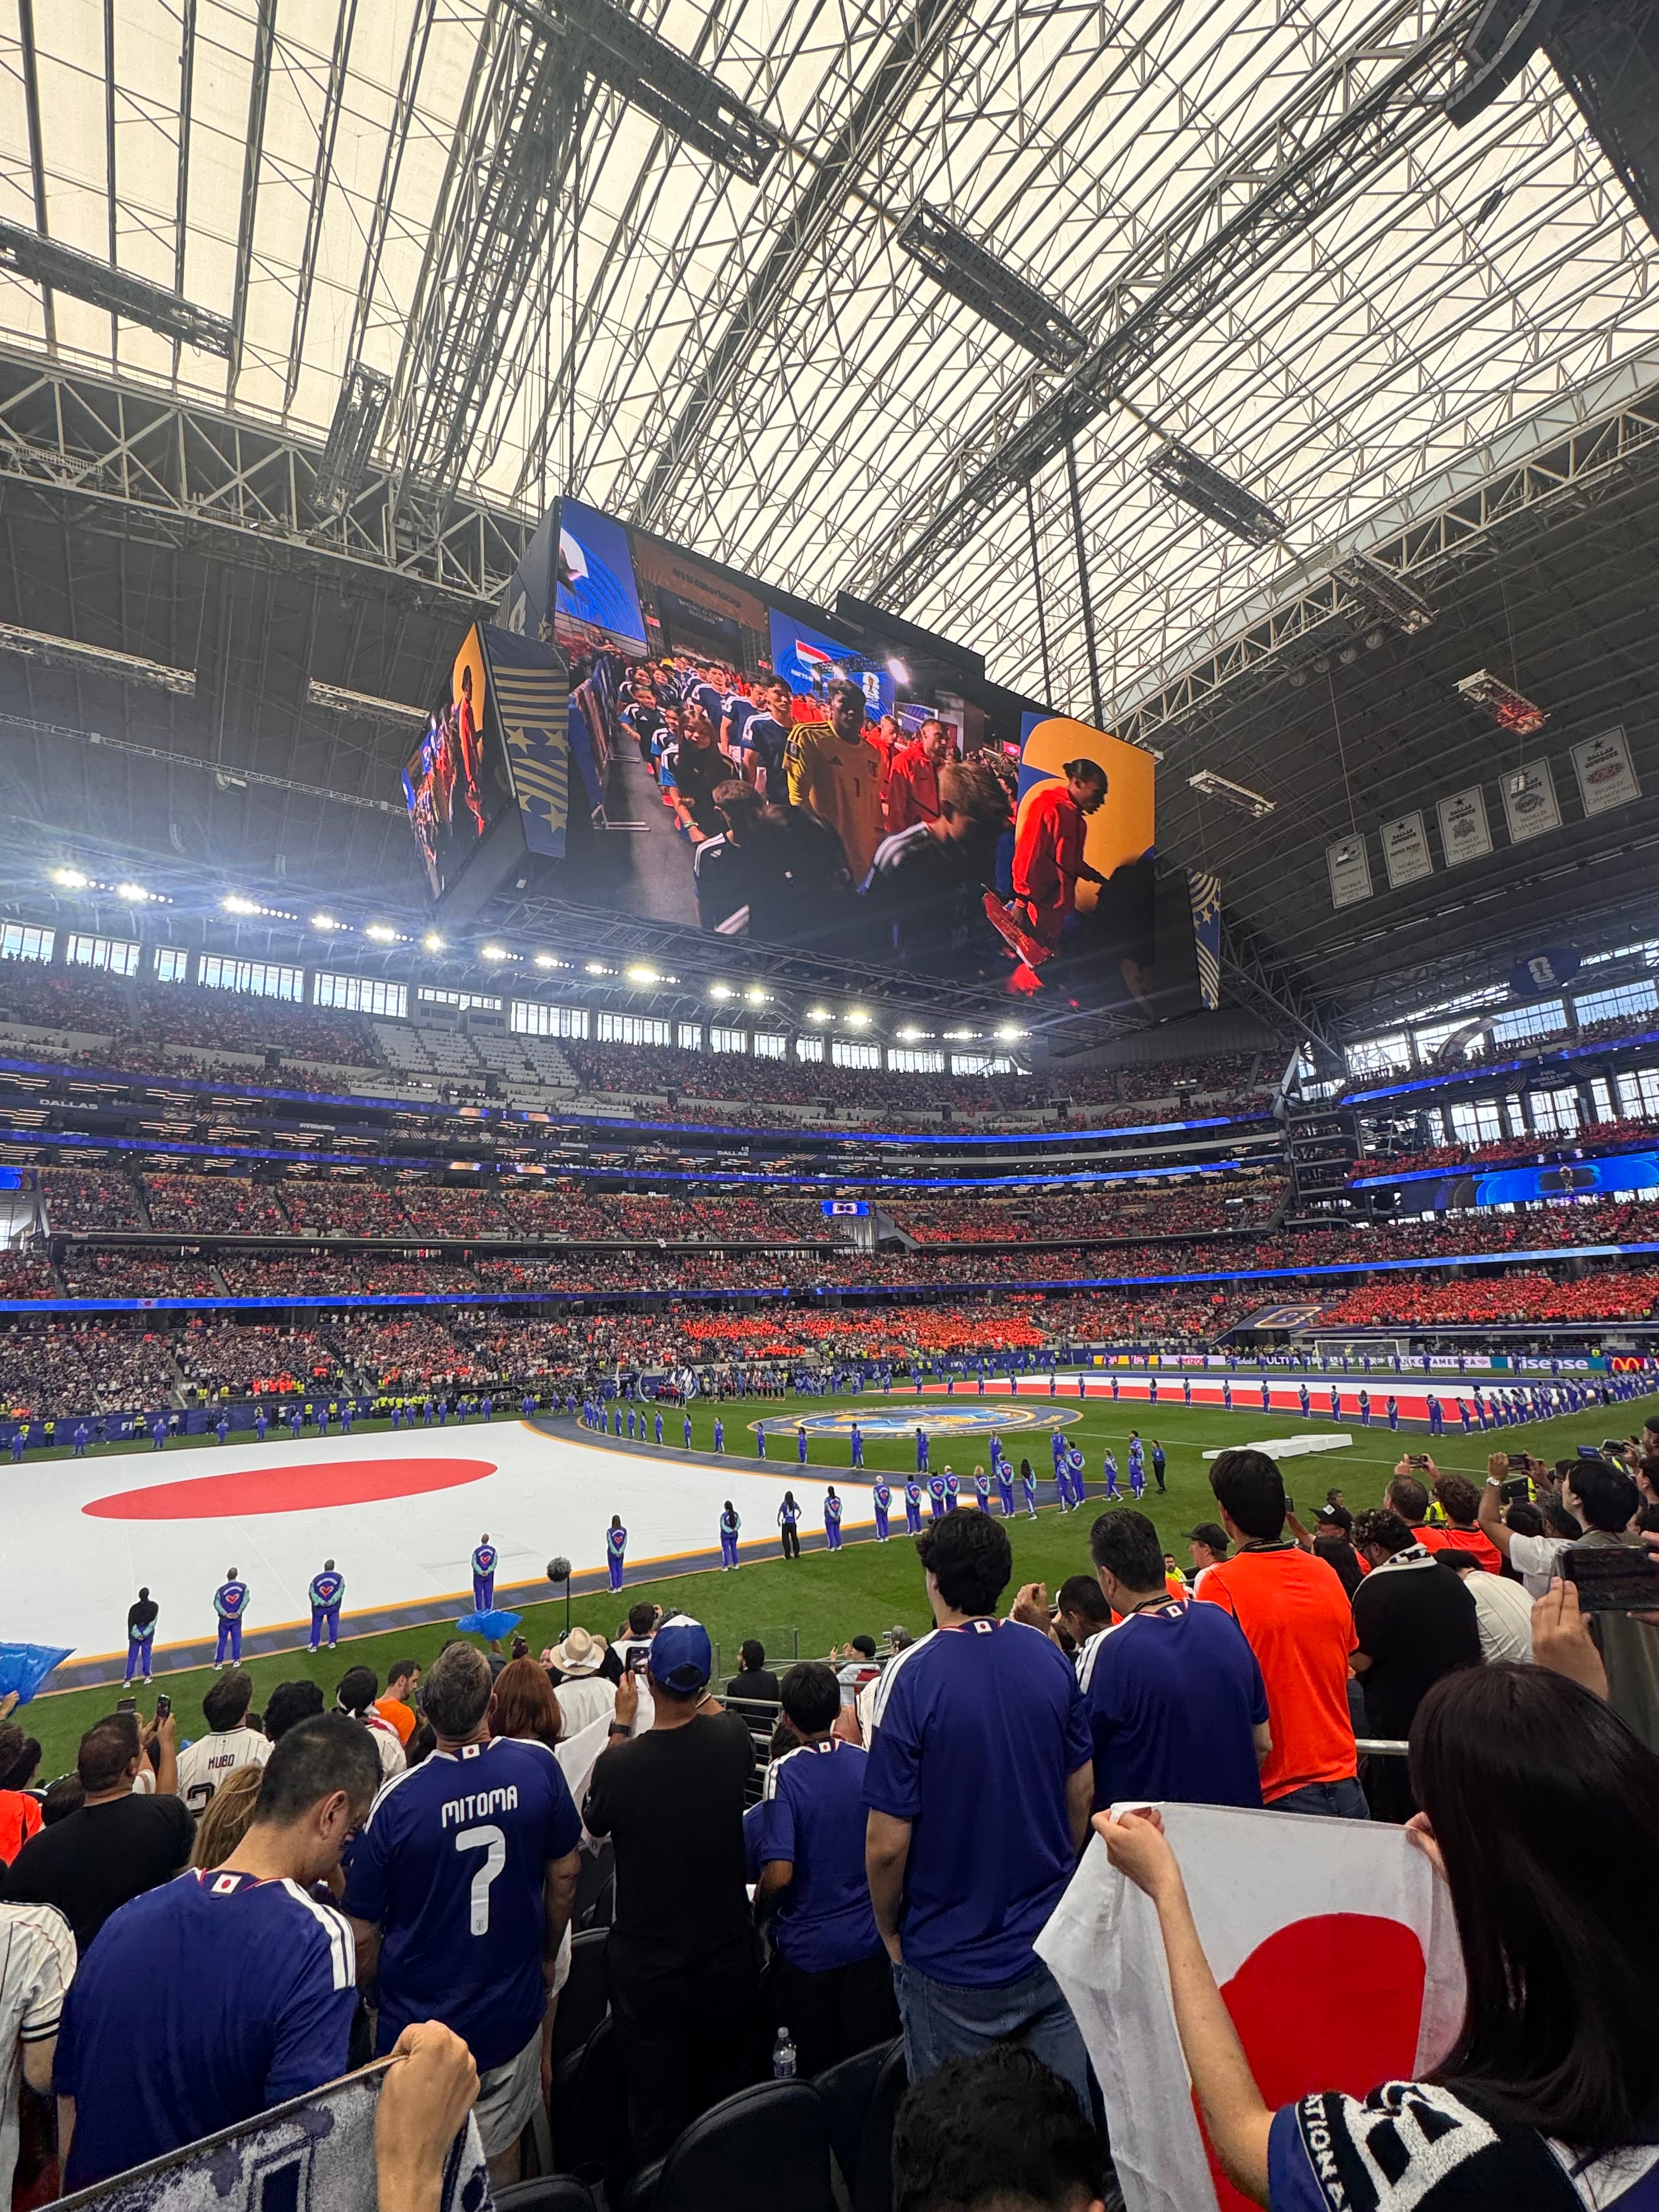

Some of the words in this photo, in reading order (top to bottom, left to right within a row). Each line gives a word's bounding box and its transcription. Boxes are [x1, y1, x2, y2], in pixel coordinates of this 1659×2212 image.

[1585, 751, 1618, 768] COWBOYS
[1587, 746, 1614, 761] DALLAS
[1594, 781, 1623, 794] WORLD
[1448, 808, 1476, 822] COWBOYS
[1450, 804, 1472, 816] DALLAS
[1519, 809, 1547, 823] WORLD
[1513, 812, 1556, 832] CHAMPIONS
[1392, 828, 1413, 840] DALLAS
[1454, 835, 1479, 848] WORLD
[1398, 859, 1420, 870] WORLD
[1530, 1075, 1556, 1084] WORLD
[40, 1099, 99, 1110] DALLAS
[1266, 1356, 1300, 1365] ULTA
[208, 1754, 235, 1770] KUBO
[441, 1785, 518, 1828] MITOMA
[455, 1824, 506, 1937] 7
